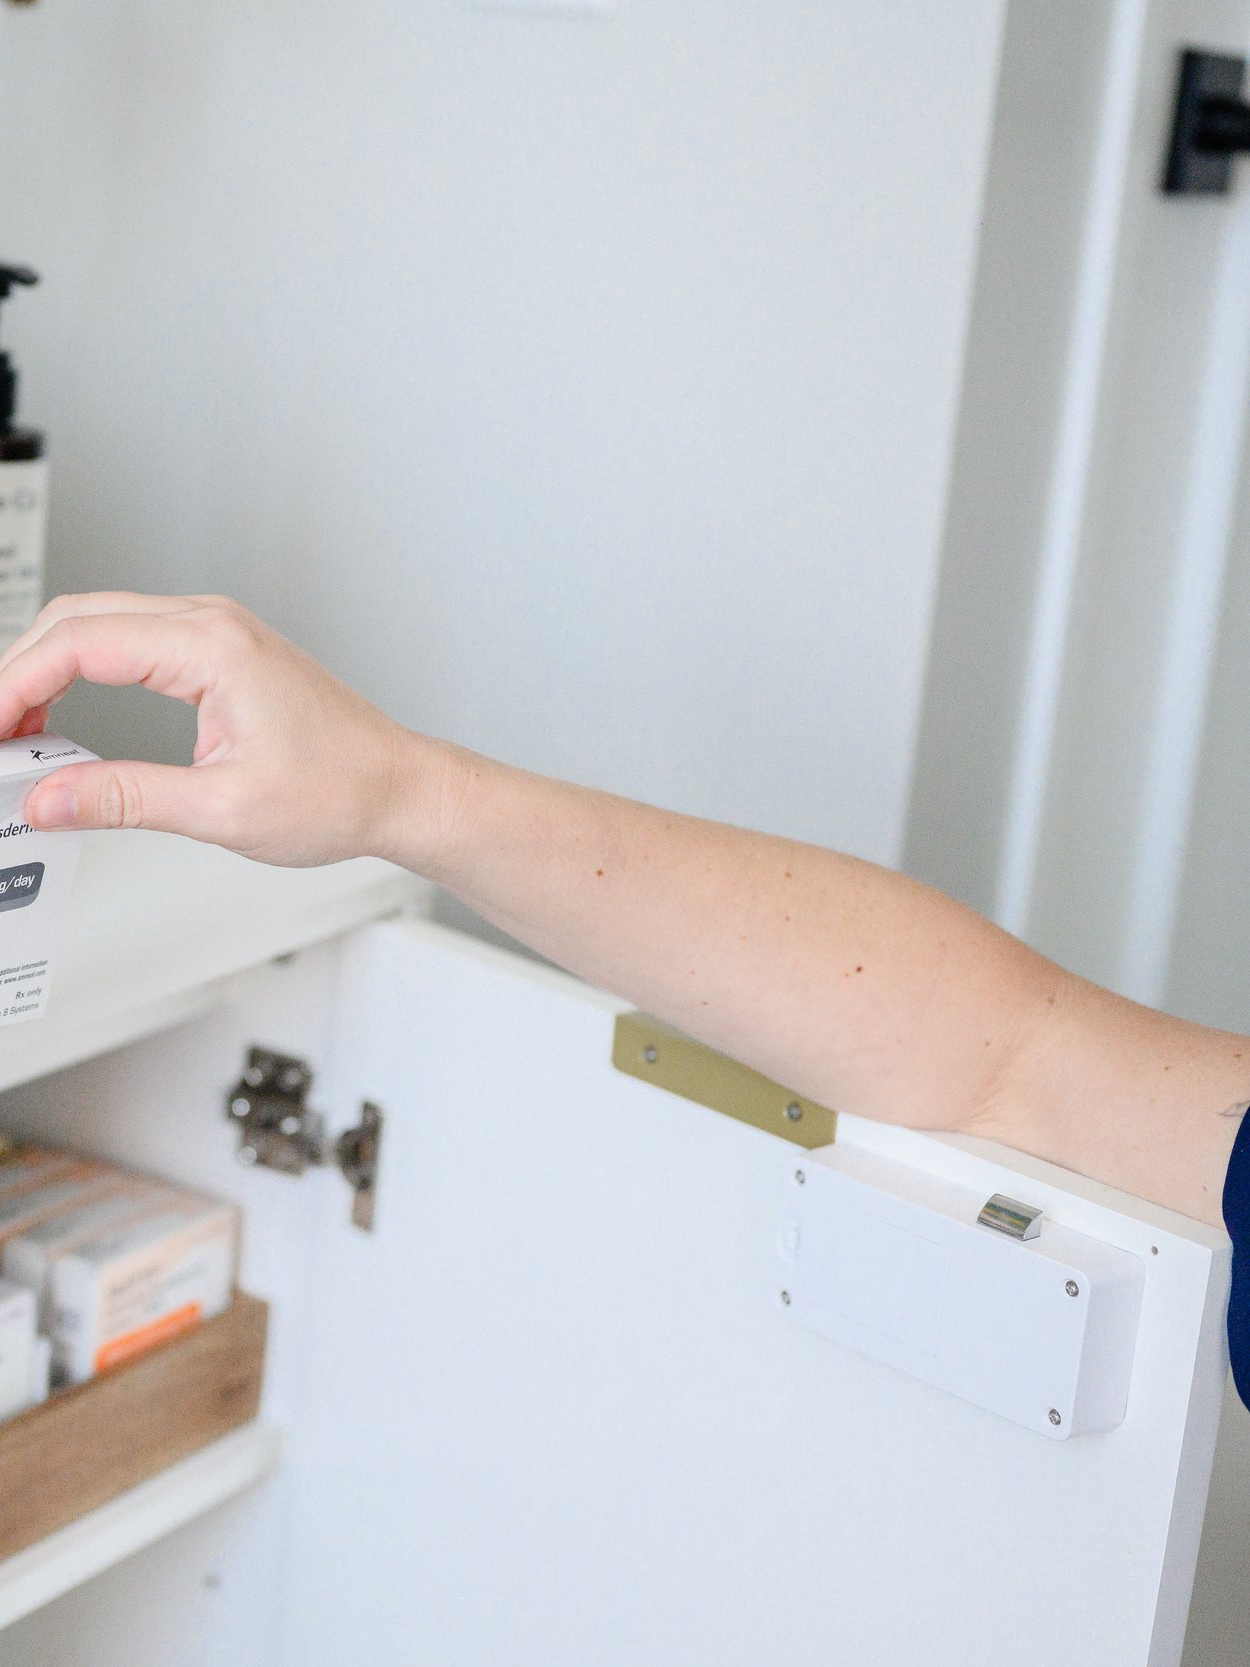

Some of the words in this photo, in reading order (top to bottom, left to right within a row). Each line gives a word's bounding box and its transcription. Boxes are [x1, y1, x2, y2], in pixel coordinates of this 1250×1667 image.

[15, 991, 25, 1000] Rx
[26, 987, 43, 997] only
[2, 1007, 10, 1017] 8
[9, 1002, 40, 1016] Systems
